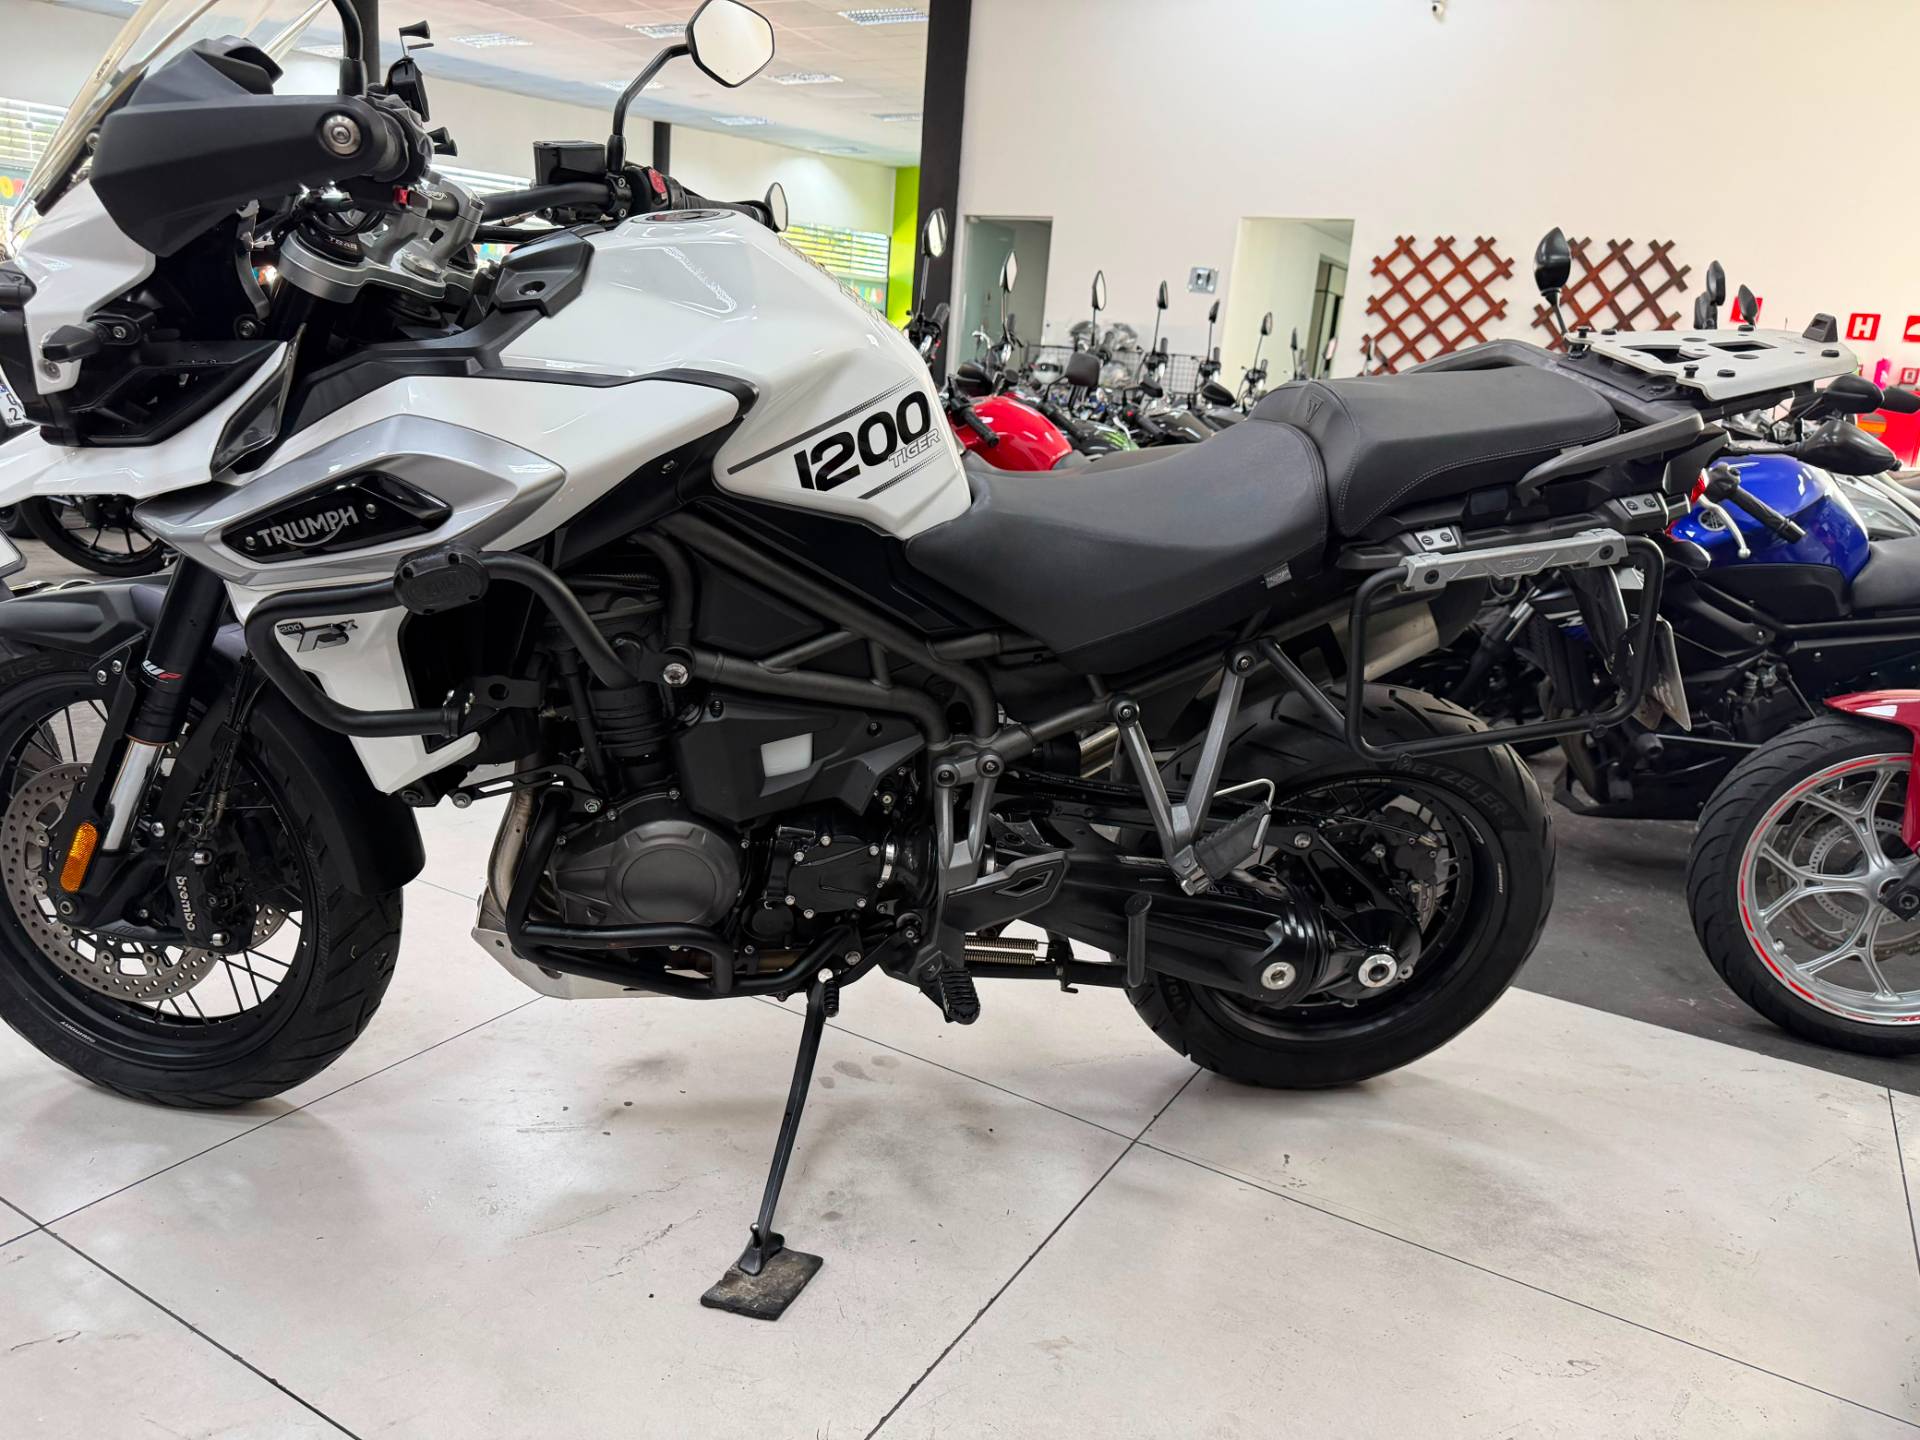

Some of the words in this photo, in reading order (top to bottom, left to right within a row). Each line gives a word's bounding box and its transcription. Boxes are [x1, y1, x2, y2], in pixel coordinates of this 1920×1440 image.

[1852, 316, 1875, 339] H
[794, 390, 931, 491] 1200
[887, 428, 941, 468] TIGER
[256, 505, 360, 547] TRIUMPH
[175, 875, 197, 931] brembo
